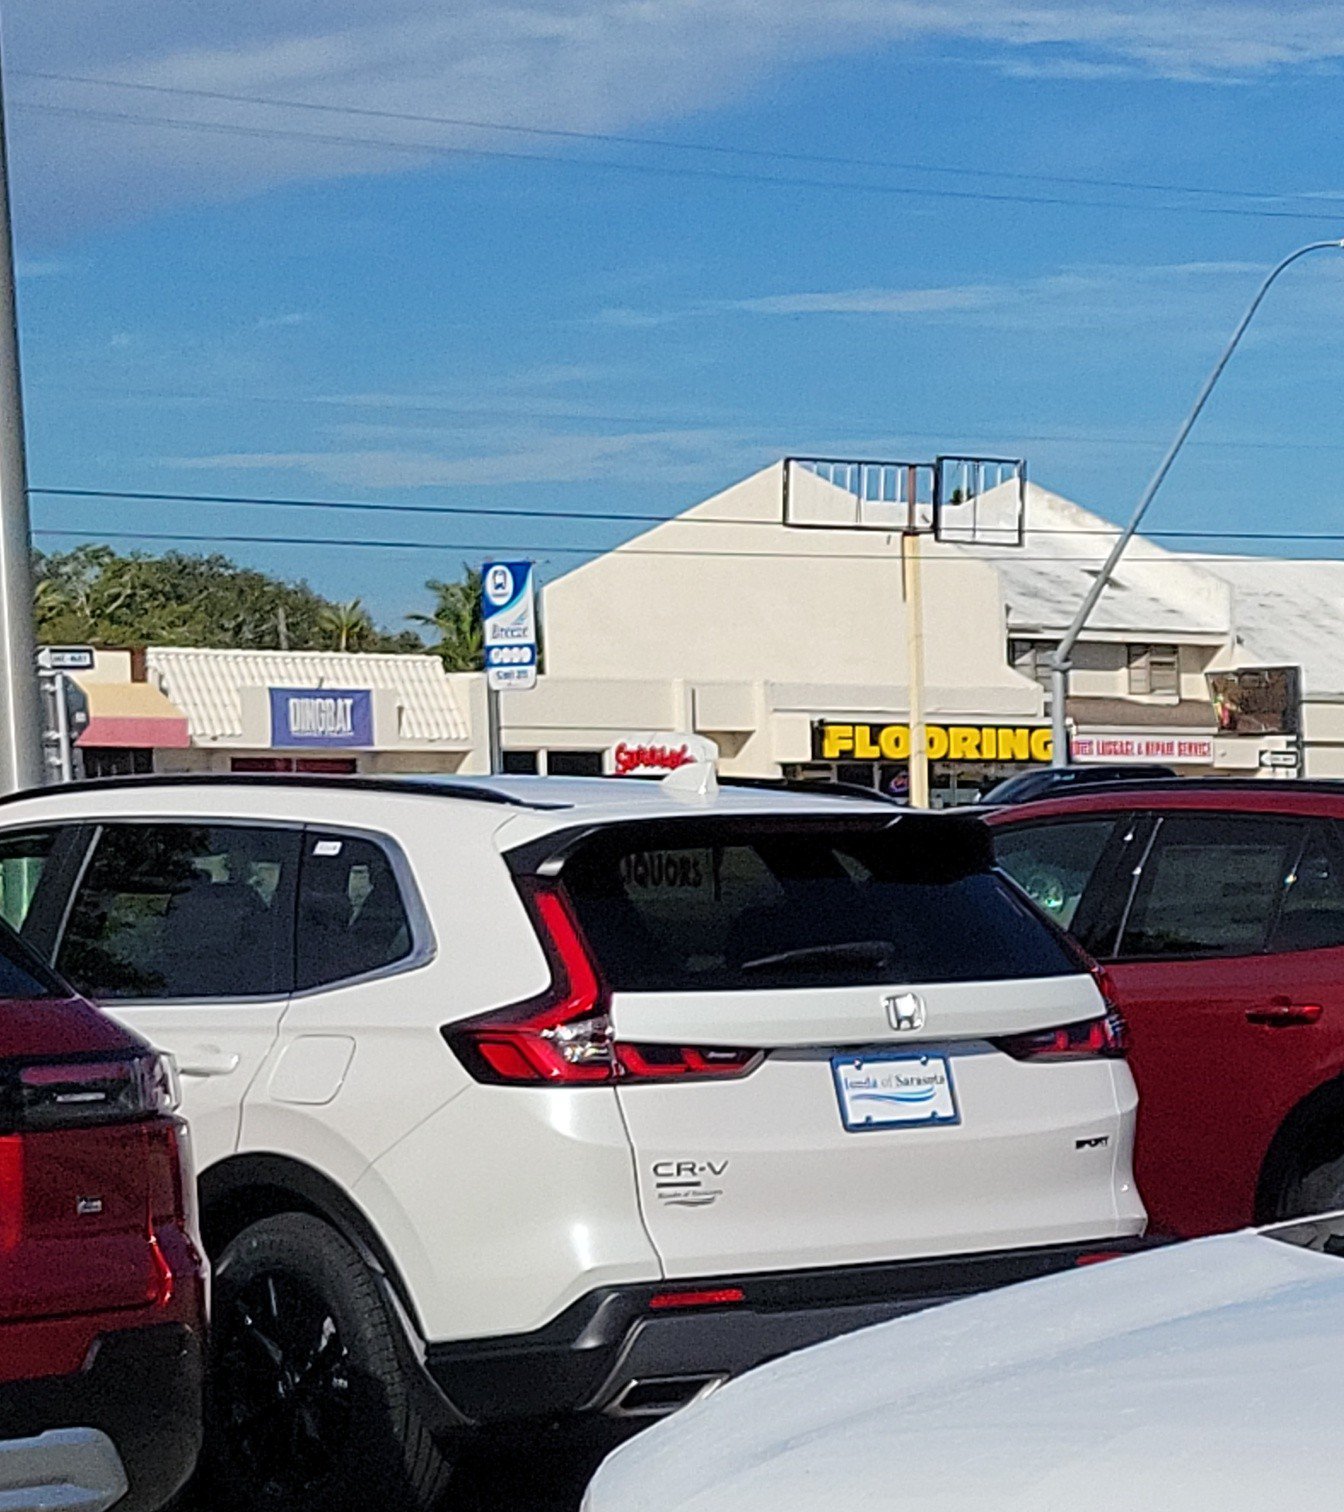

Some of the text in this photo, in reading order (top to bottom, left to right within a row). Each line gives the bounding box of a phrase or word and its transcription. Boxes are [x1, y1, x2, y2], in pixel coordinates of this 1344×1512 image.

[288, 698, 354, 732] DINGBAT
[822, 724, 1054, 762] FLOORING
[881, 1073, 893, 1089] of
[894, 1073, 945, 1087] Sarasota
[652, 1160, 729, 1177] CR-V
